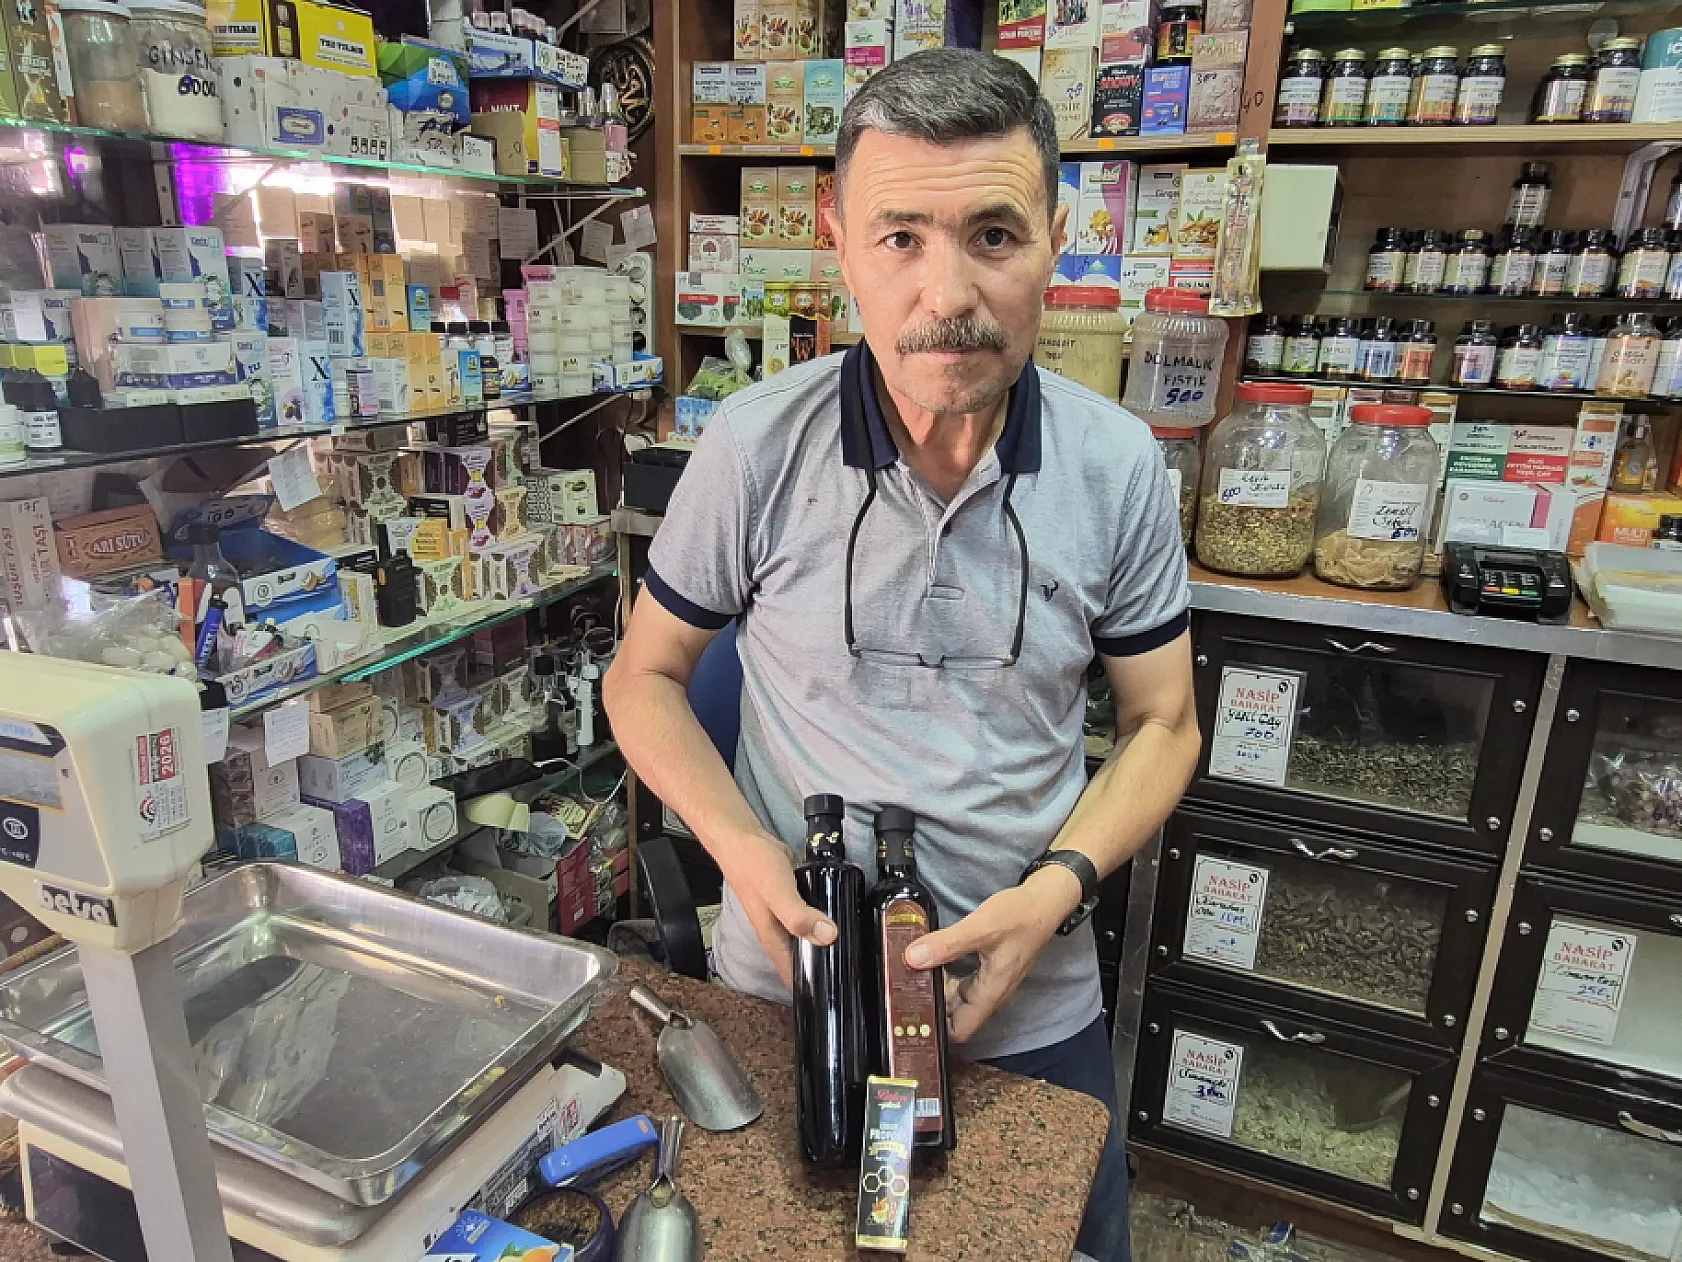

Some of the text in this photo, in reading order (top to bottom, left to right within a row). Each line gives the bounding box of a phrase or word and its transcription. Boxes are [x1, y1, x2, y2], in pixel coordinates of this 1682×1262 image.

[1236, 687, 1280, 702] NASİP
[1230, 699, 1283, 713] BAHARAT
[1208, 875, 1251, 891] NASİP
[1203, 884, 1254, 902] BAHARAT
[1561, 941, 1613, 960] NASİP
[1554, 952, 1617, 972] BAHARAT
[1186, 1048, 1227, 1066] NASİP
